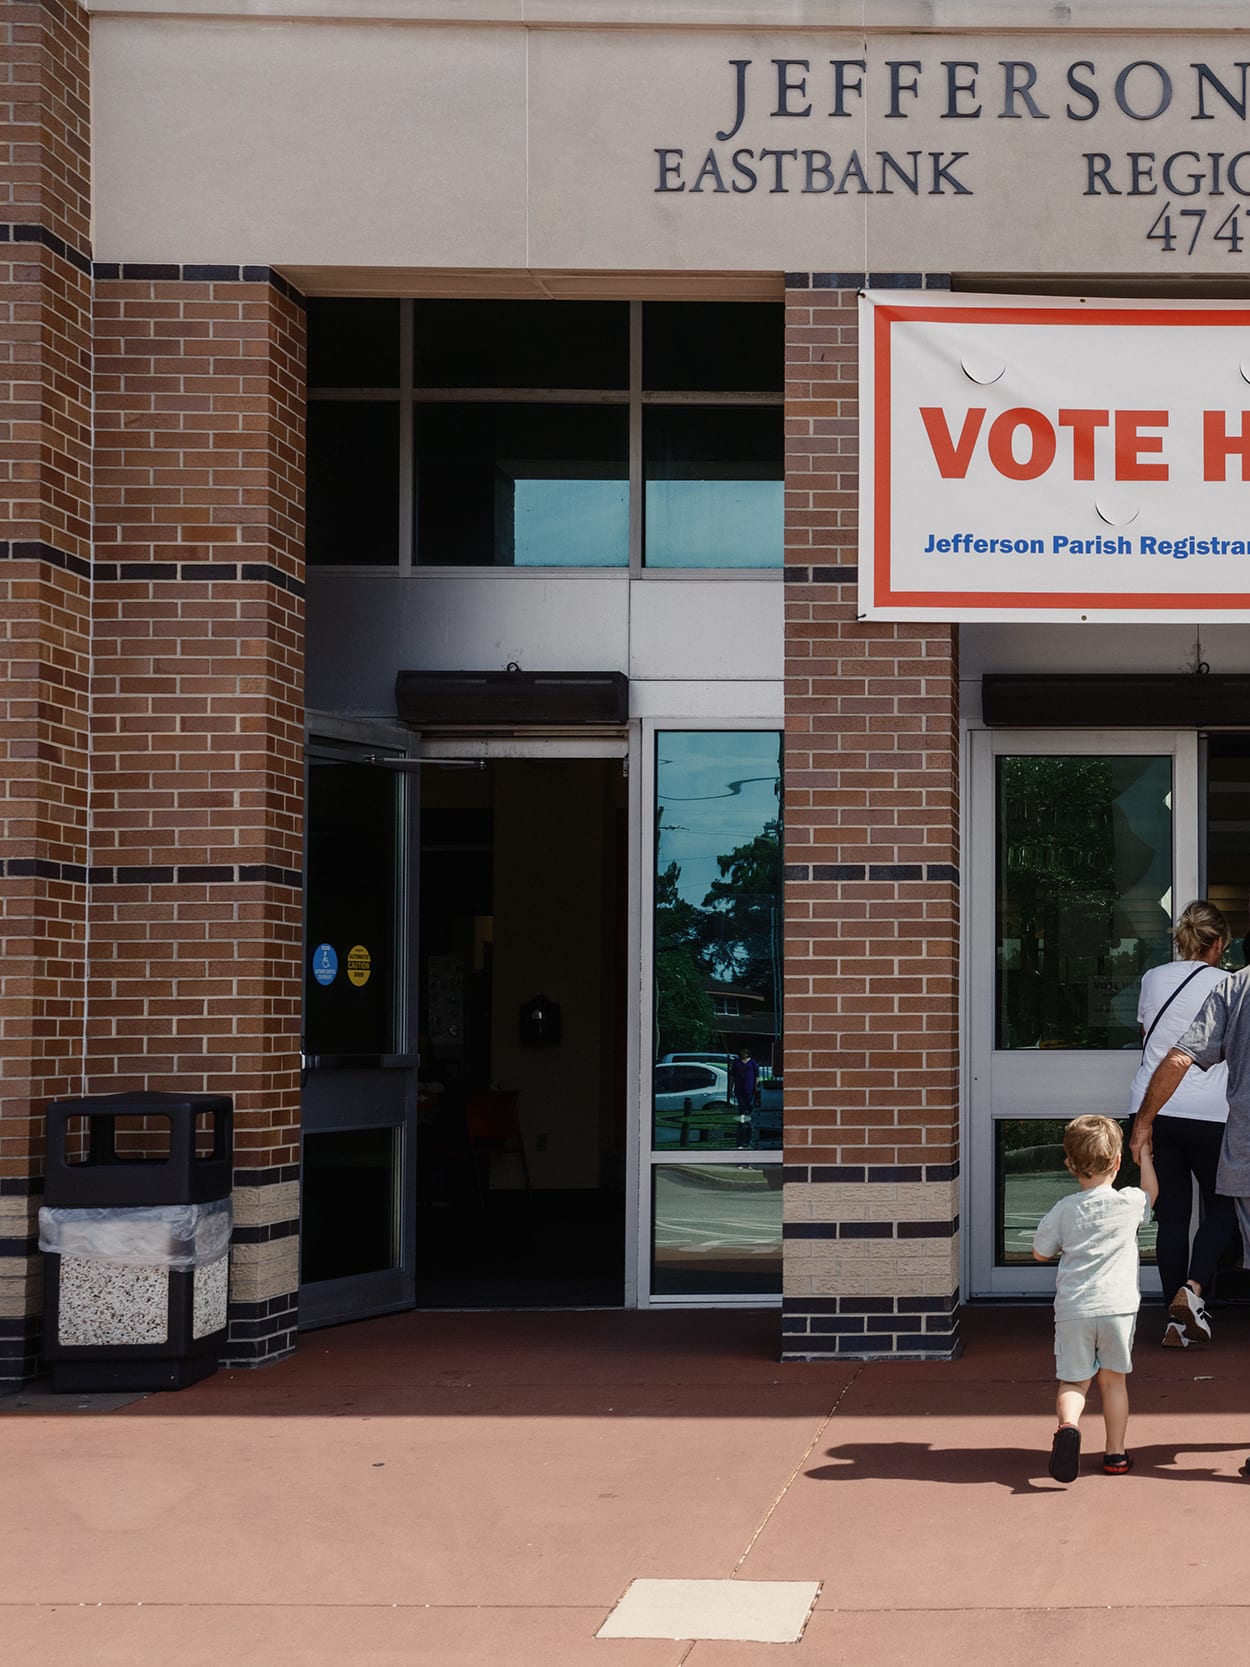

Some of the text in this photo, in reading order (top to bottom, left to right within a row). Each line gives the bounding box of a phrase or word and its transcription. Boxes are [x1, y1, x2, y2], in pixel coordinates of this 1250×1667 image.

[653, 148, 975, 196] EASTBANK
[919, 407, 1170, 481] VOTE
[924, 534, 1045, 555] Jefferson
[1052, 535, 1133, 556] Parish
